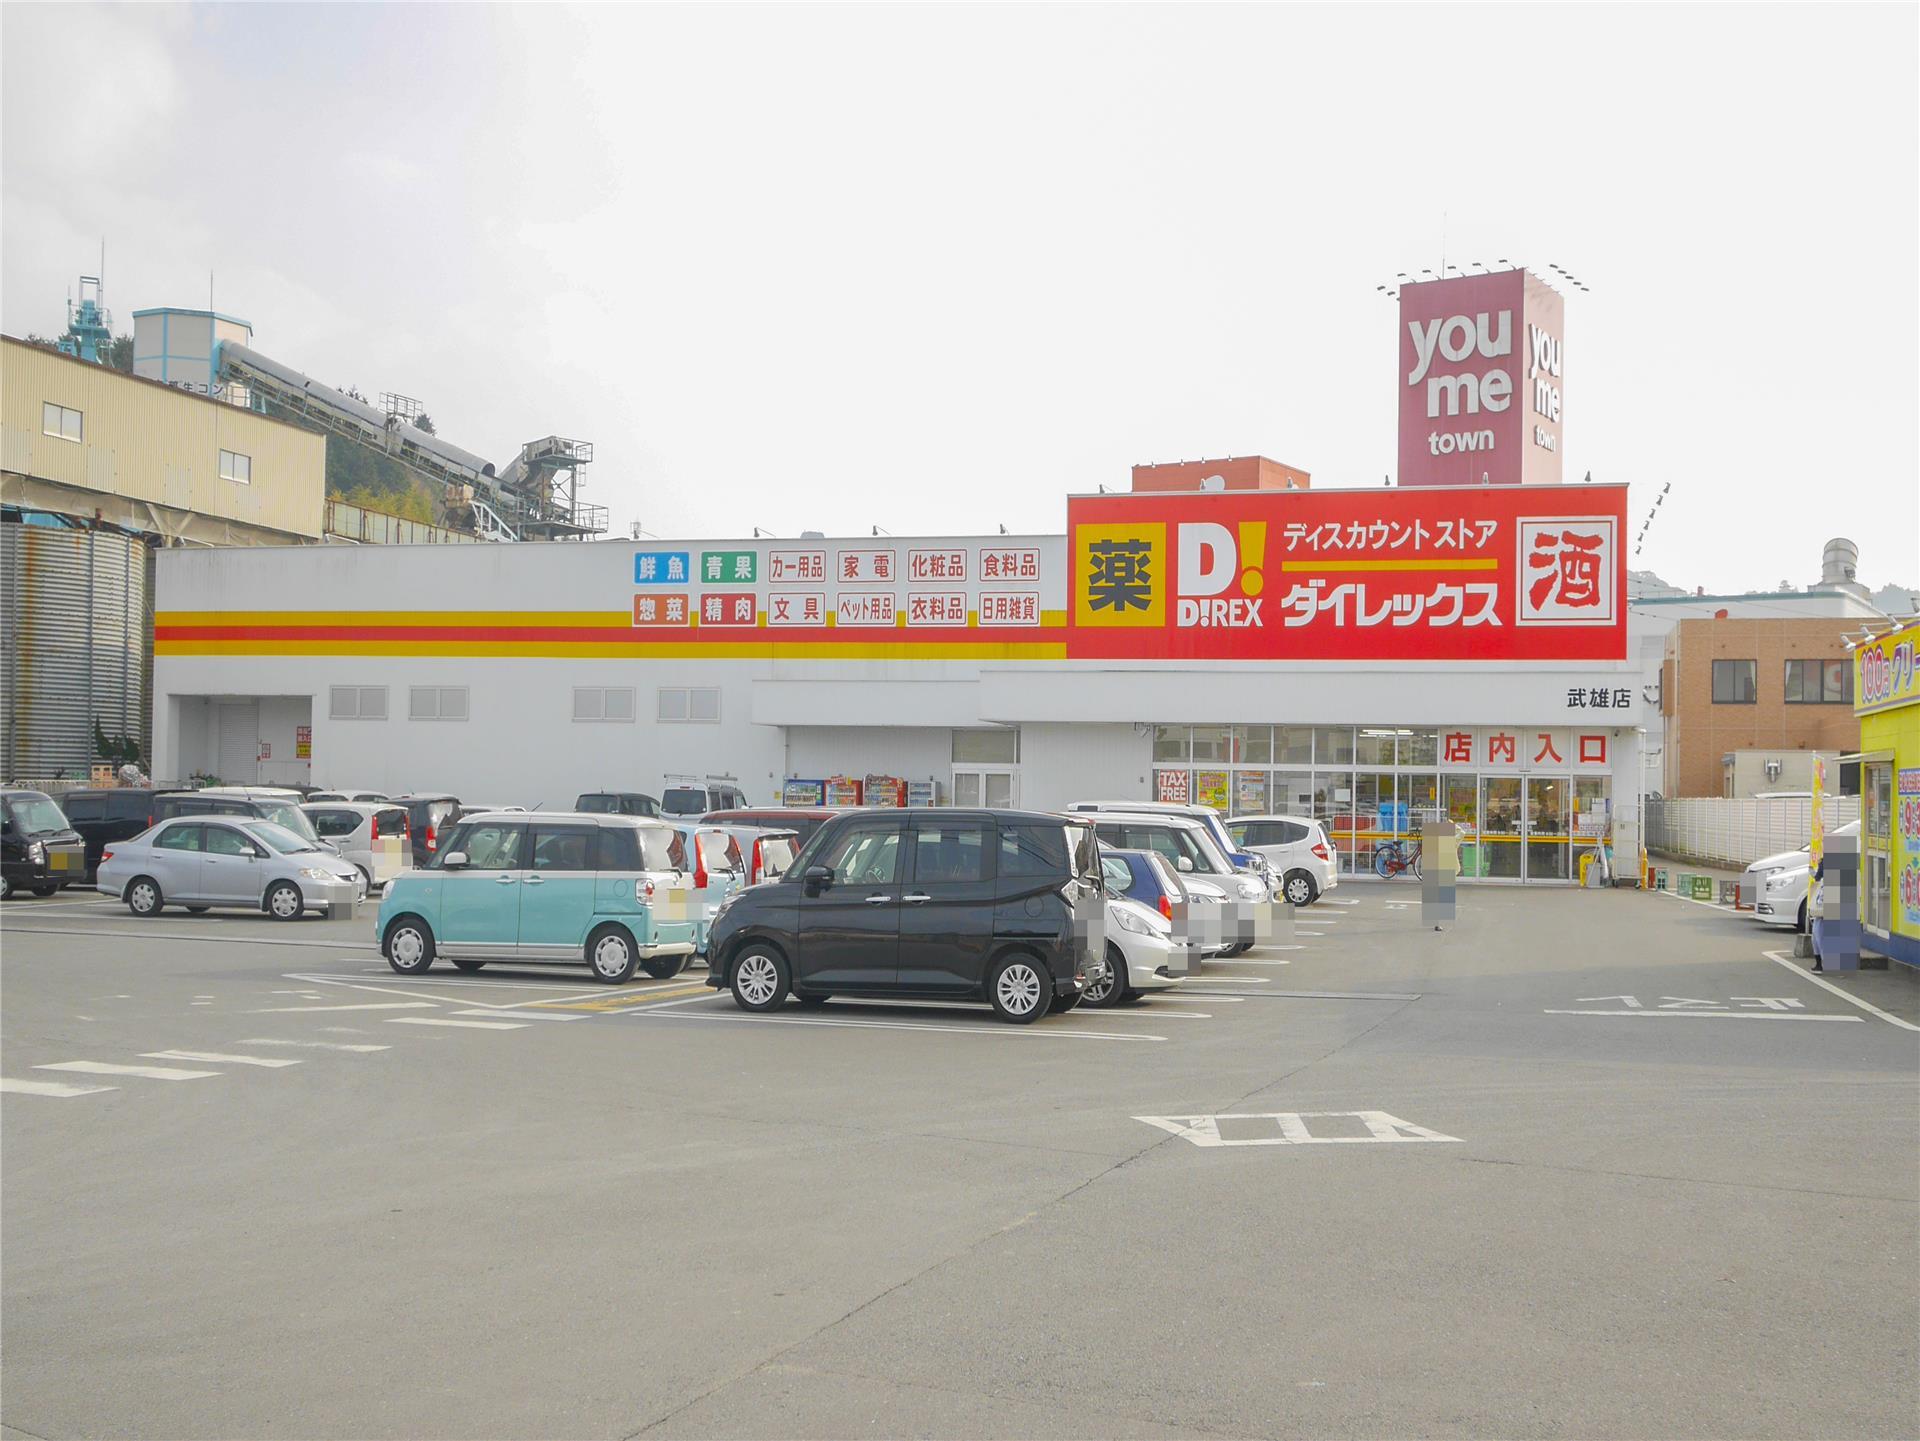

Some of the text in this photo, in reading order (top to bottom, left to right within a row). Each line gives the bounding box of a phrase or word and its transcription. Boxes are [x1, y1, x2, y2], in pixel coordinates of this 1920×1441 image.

[1408, 310, 1512, 385] you
[1529, 323, 1561, 379] you
[1427, 369, 1513, 418] me
[1534, 377, 1560, 423] me
[1428, 429, 1495, 455] town
[1534, 425, 1556, 452] town
[1283, 518, 1498, 551] ディスカウントストア
[639, 556, 685, 580] 鮮魚
[706, 555, 752, 580] 青果
[772, 555, 823, 578] カー用品
[843, 554, 890, 578] 家電
[912, 554, 964, 578] 化粧品
[983, 553, 1036, 577] 食料品
[1088, 539, 1152, 612] 薬
[1528, 530, 1604, 611] 酒
[639, 597, 684, 622] 惣菜
[705, 596, 752, 622] 精肉
[774, 597, 820, 621] 文具
[840, 597, 893, 621] ペット用品
[911, 596, 964, 620] 衣料品
[983, 596, 1036, 620] 日用雑貨
[1281, 579, 1503, 627] ダイレックス
[1567, 688, 1632, 709] 武雄店
[1443, 731, 1607, 764] 店内入口
[1160, 770, 1187, 786] TAX
[1160, 786, 1187, 801] FREE
